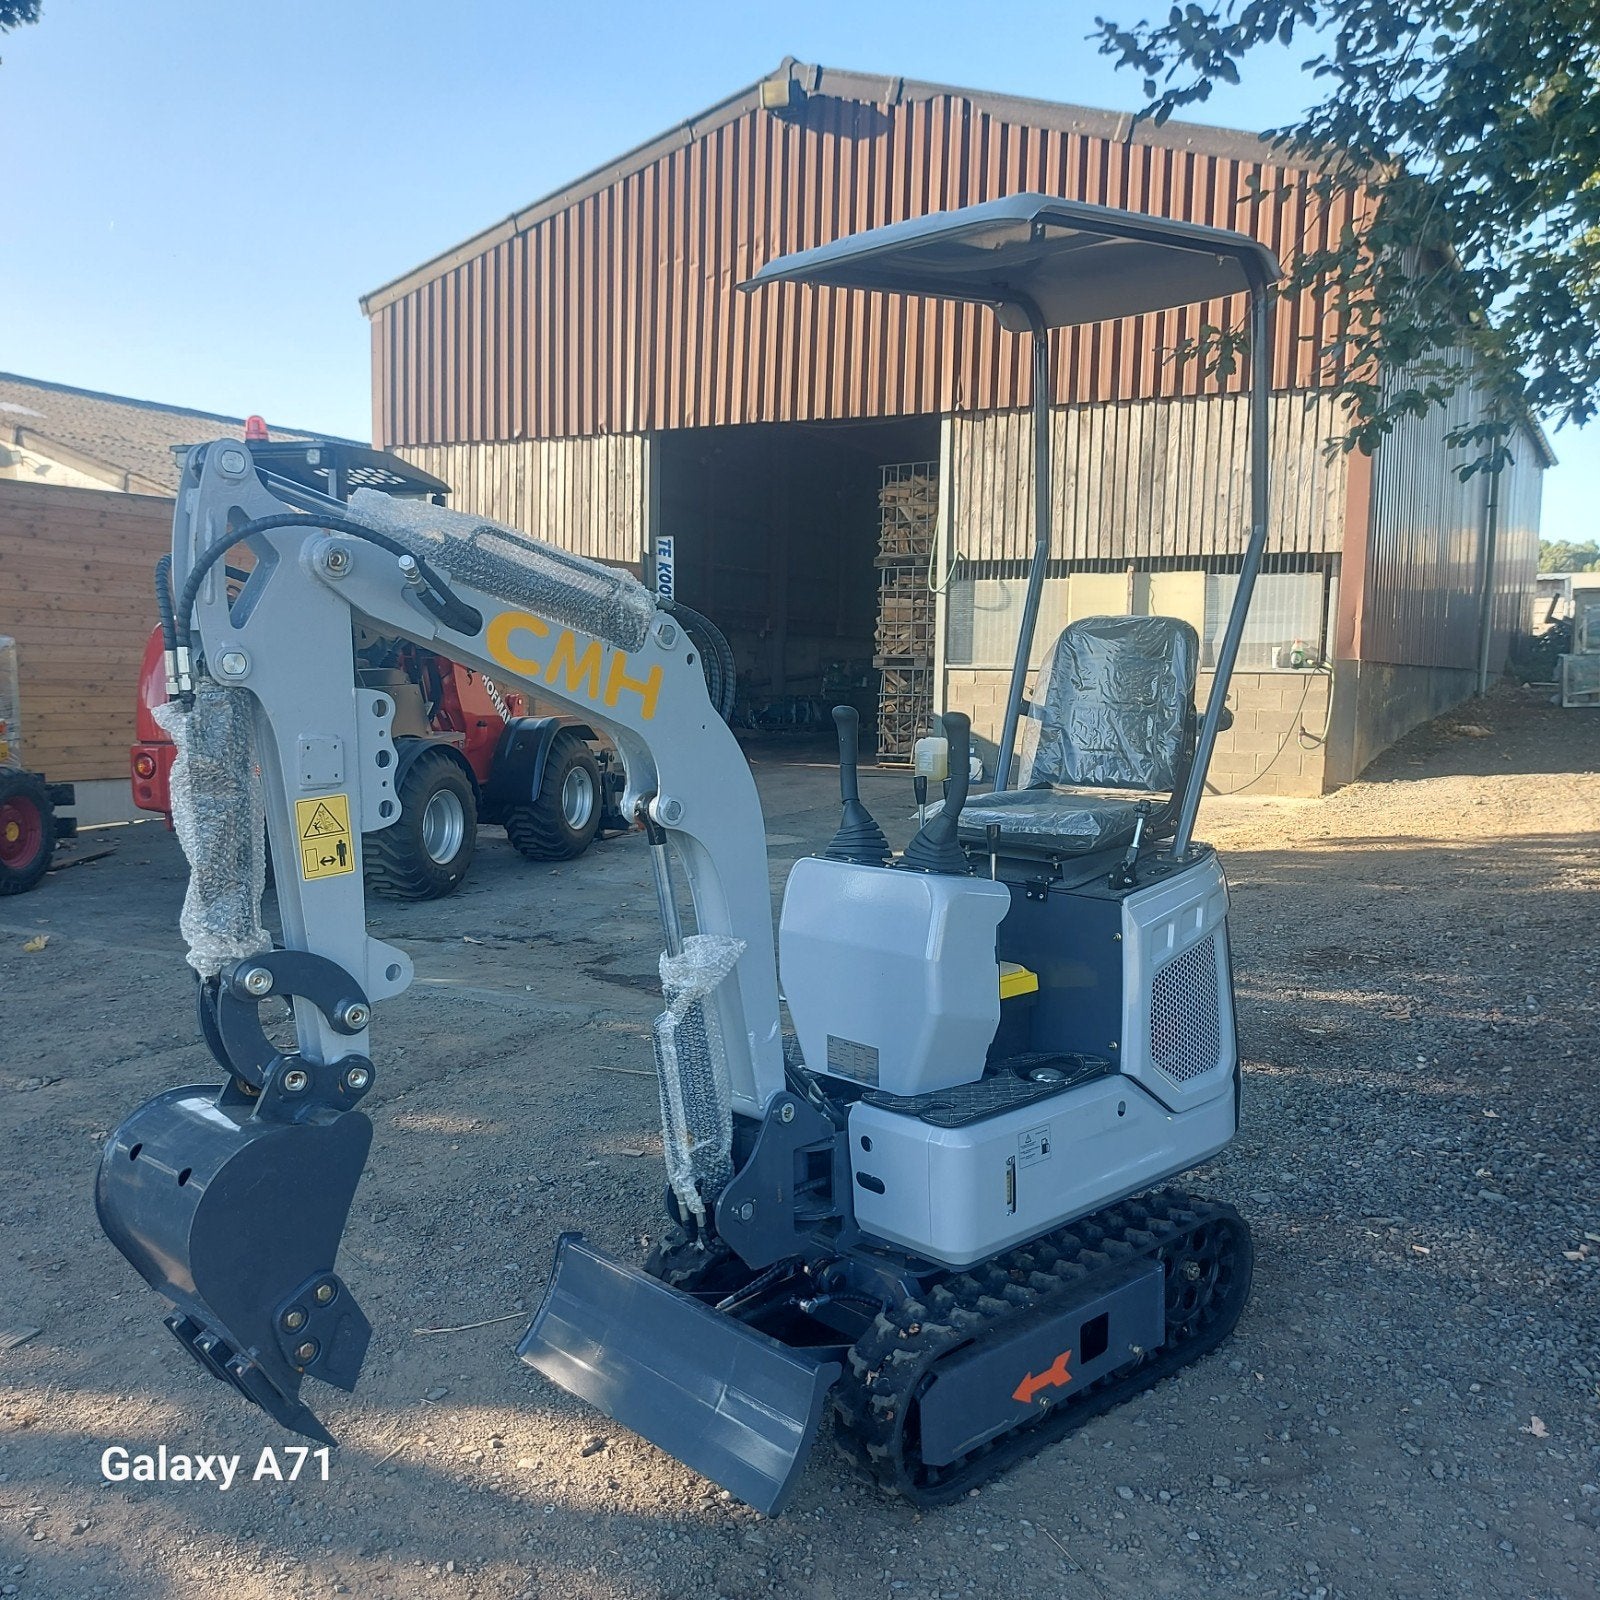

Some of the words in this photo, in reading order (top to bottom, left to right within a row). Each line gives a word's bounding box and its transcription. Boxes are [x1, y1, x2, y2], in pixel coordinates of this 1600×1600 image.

[658, 539, 672, 558] TE
[657, 561, 673, 600] KOO
[486, 611, 664, 721] CMH
